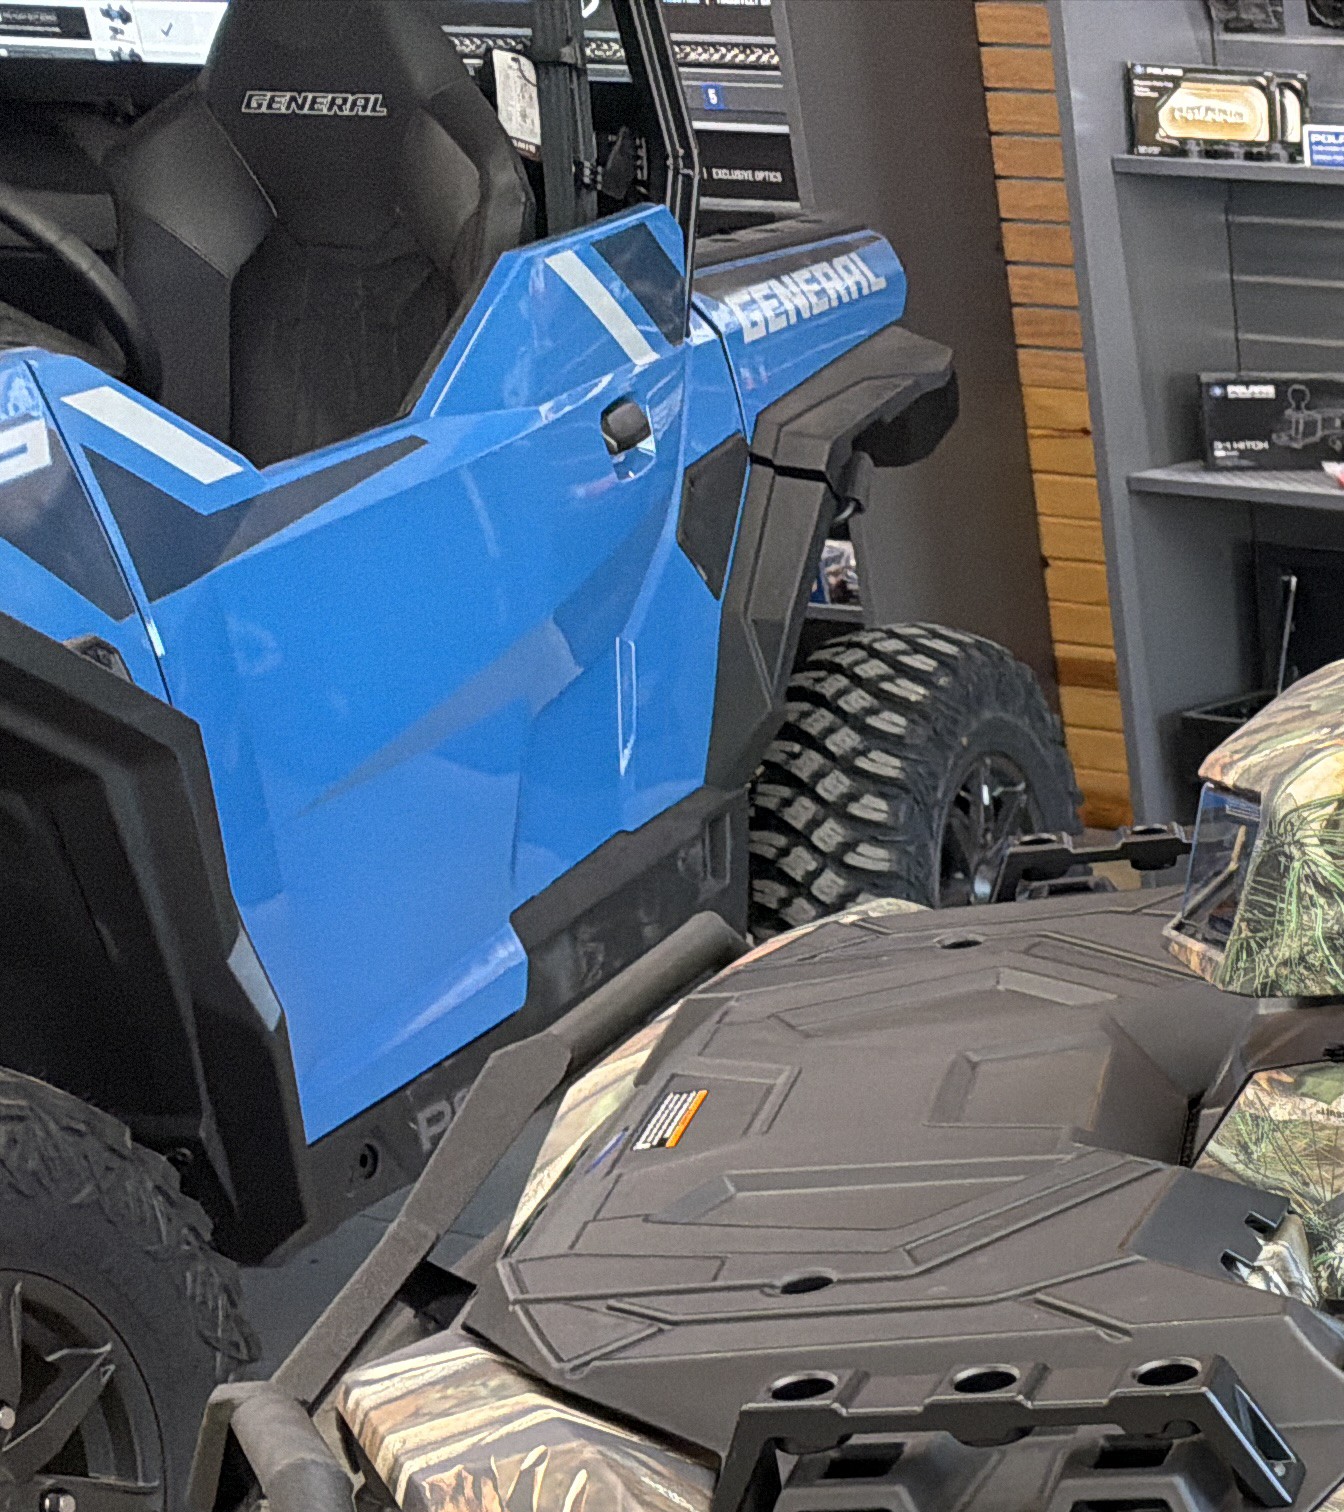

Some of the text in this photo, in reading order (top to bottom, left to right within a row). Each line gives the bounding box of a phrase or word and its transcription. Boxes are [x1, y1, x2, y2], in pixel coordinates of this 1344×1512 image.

[241, 91, 387, 116] GENERAL
[707, 87, 719, 105] 5
[754, 168, 783, 184] OPTICS
[724, 251, 887, 344] GENERAL
